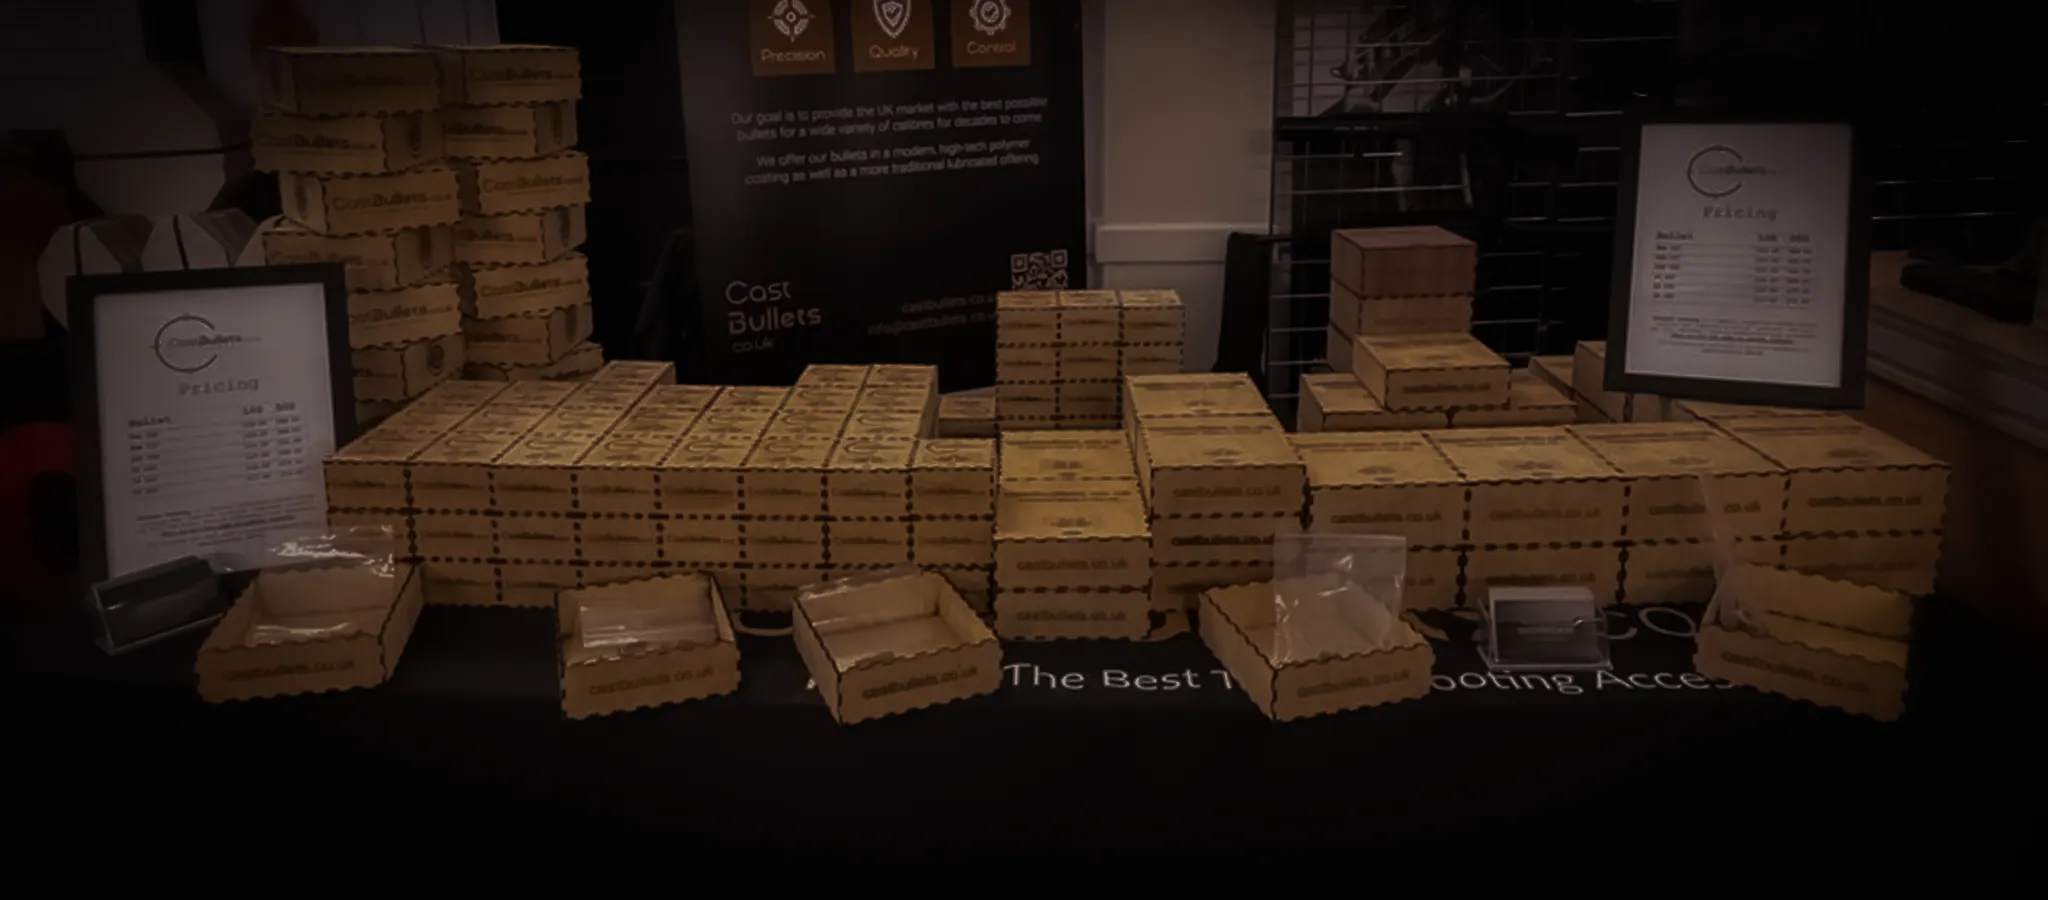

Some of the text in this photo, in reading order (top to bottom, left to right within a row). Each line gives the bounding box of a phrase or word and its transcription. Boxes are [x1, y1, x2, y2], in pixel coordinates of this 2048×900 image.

[761, 48, 826, 62] Precision
[869, 45, 921, 61] Quality
[967, 40, 1018, 55] Control
[731, 112, 753, 125] Our
[756, 110, 783, 126] goal
[812, 107, 853, 122] provide
[856, 106, 875, 118] the
[896, 102, 935, 114] market
[937, 101, 960, 112] with
[962, 100, 978, 111] the
[980, 99, 1003, 110] best
[1005, 97, 1048, 111] possible
[737, 128, 777, 141] bullets
[780, 126, 796, 138] for
[810, 124, 836, 136] wide
[839, 123, 875, 135] variety
[892, 119, 935, 132] calibres
[937, 117, 951, 129] for
[954, 115, 998, 128] decades
[1013, 114, 1042, 124] come
[1703, 205, 1778, 222] Pricing
[725, 280, 792, 304] Cast
[728, 306, 822, 334] Bullets
[179, 378, 259, 396] Pricing
[1002, 661, 1085, 691] The
[1102, 667, 1202, 692] Best
[1432, 670, 1584, 695] ooting
